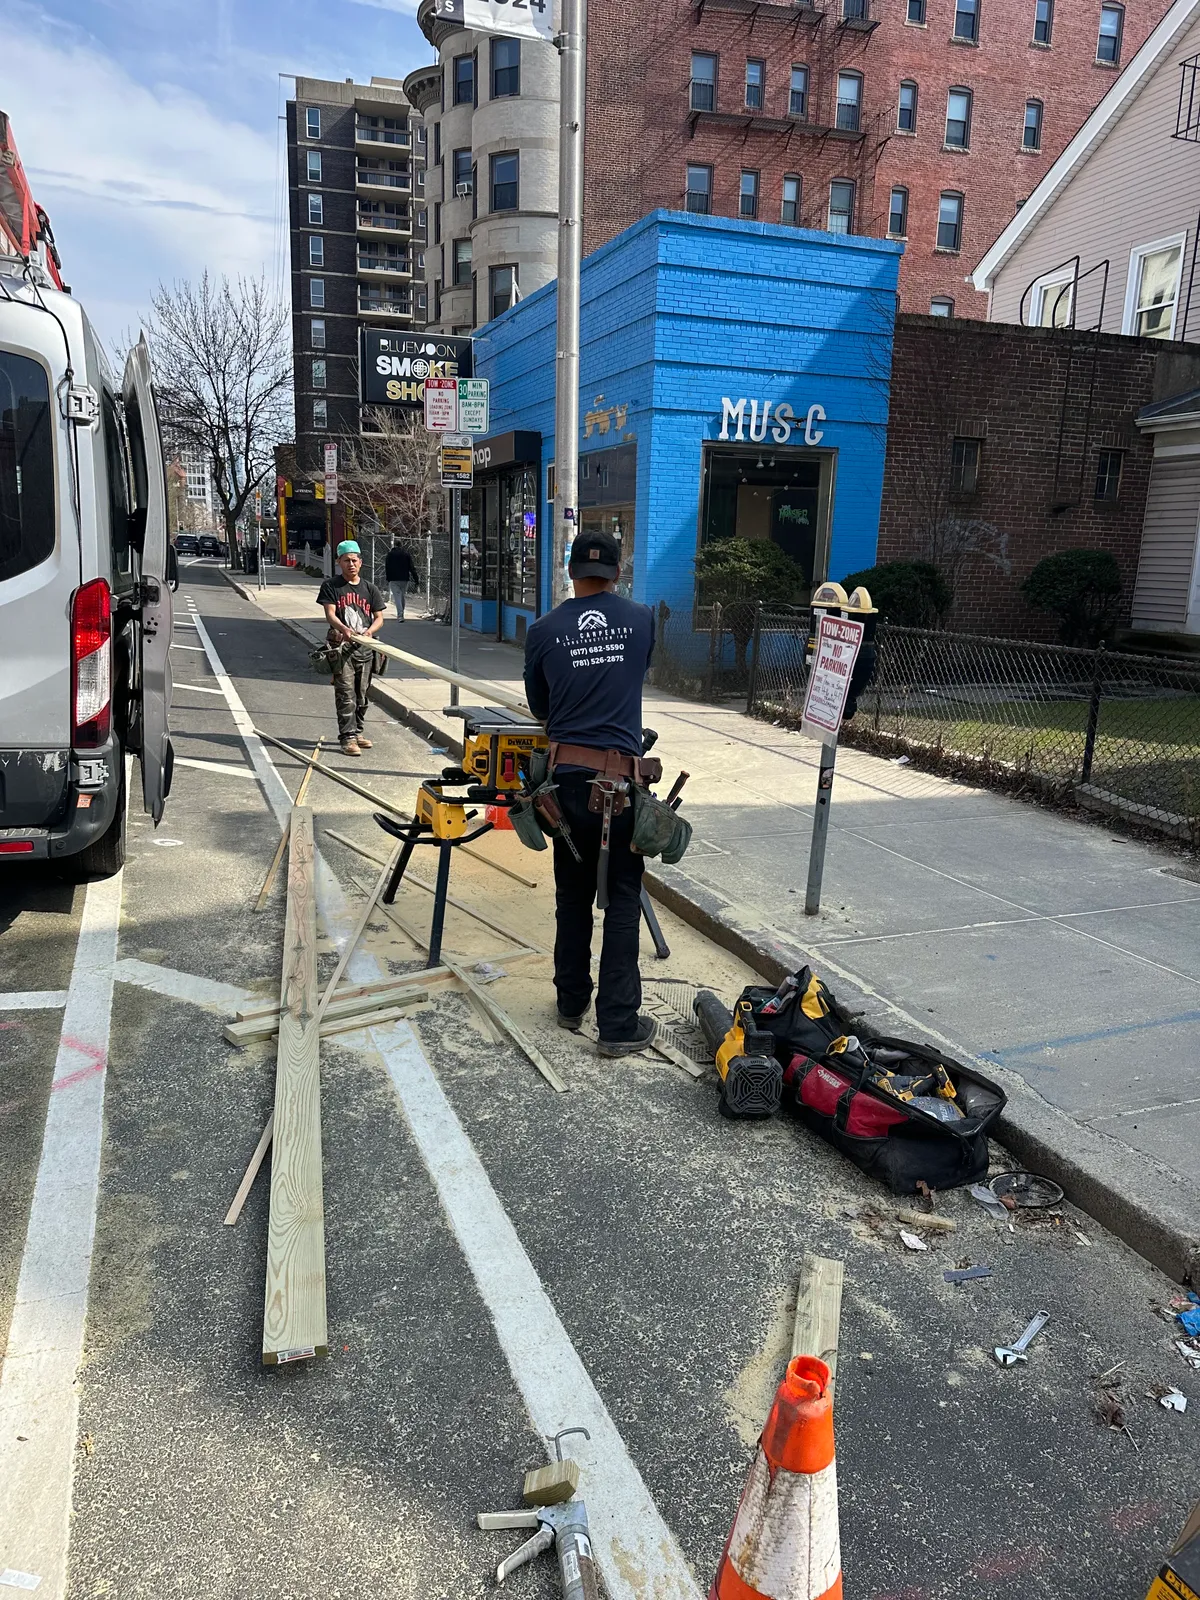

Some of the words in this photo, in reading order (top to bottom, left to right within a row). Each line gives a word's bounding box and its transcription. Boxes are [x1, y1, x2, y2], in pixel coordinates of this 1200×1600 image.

[379, 339, 457, 358] BLUEMOON
[376, 355, 459, 379] SMOKE
[428, 380, 439, 388] TOW
[459, 384, 467, 396] 30
[473, 446, 491, 468] hop
[579, 627, 633, 639] CARPENTRY
[822, 620, 860, 643] TOW-ZONE
[563, 635, 613, 647] CONSTRUCTION
[570, 647, 588, 657] (617)
[588, 643, 625, 654] 682-5590
[832, 644, 843, 658] NO
[572, 658, 590, 668] (781)
[590, 655, 624, 665] 526-2875
[819, 656, 848, 676] PARKING
